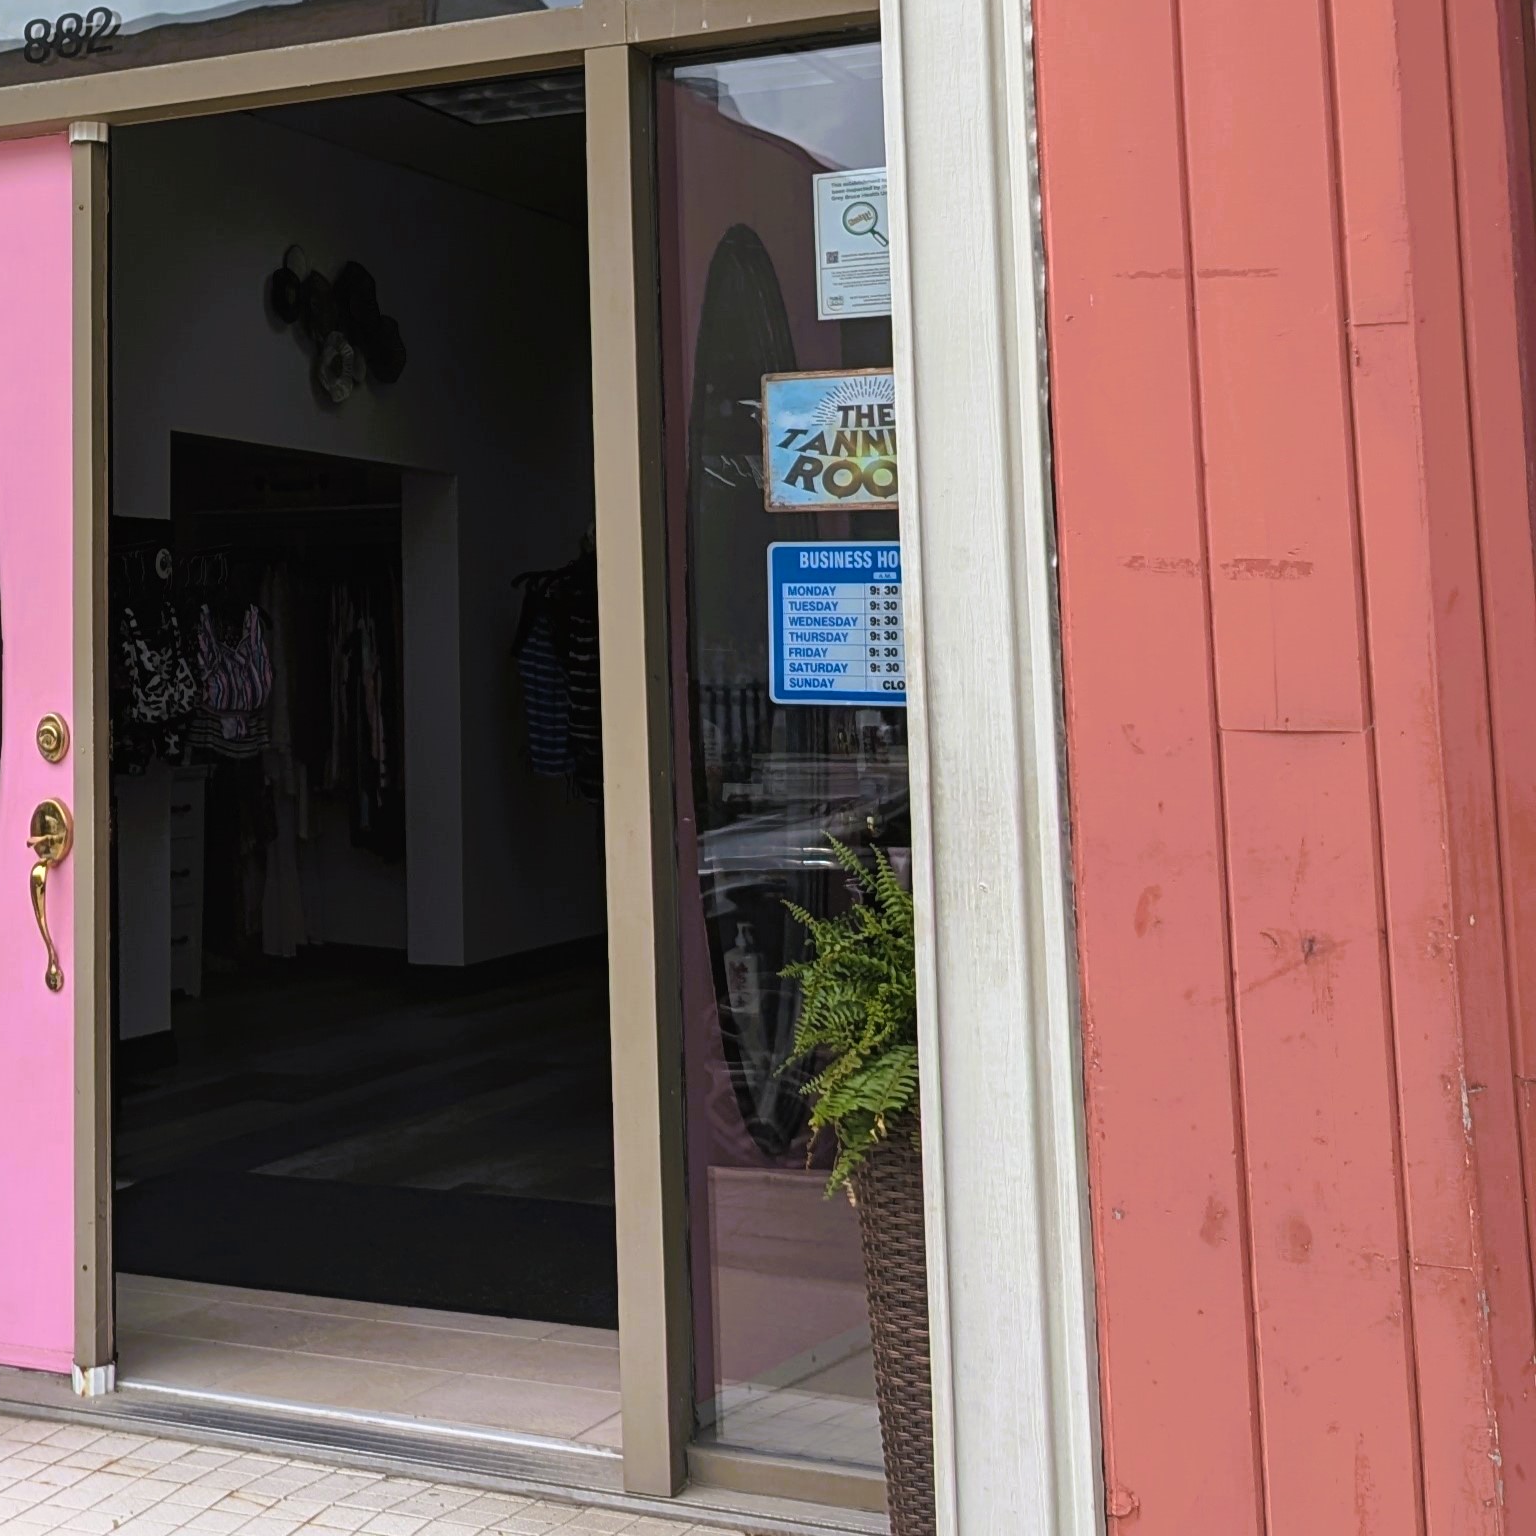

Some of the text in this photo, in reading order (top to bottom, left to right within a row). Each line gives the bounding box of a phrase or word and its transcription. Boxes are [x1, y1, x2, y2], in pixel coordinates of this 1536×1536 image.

[24, 6, 114, 64] 882
[837, 403, 896, 428] THE
[799, 550, 900, 569] BUSINESS HO
[787, 585, 837, 597] MONDAY
[788, 600, 839, 612] TUESDAY
[788, 615, 859, 627] WEDNESDAY
[789, 631, 849, 643] THURSDAY
[788, 647, 829, 658] FRIDAY
[789, 662, 849, 674] SATURDAY
[789, 677, 835, 689] SUNDAY
